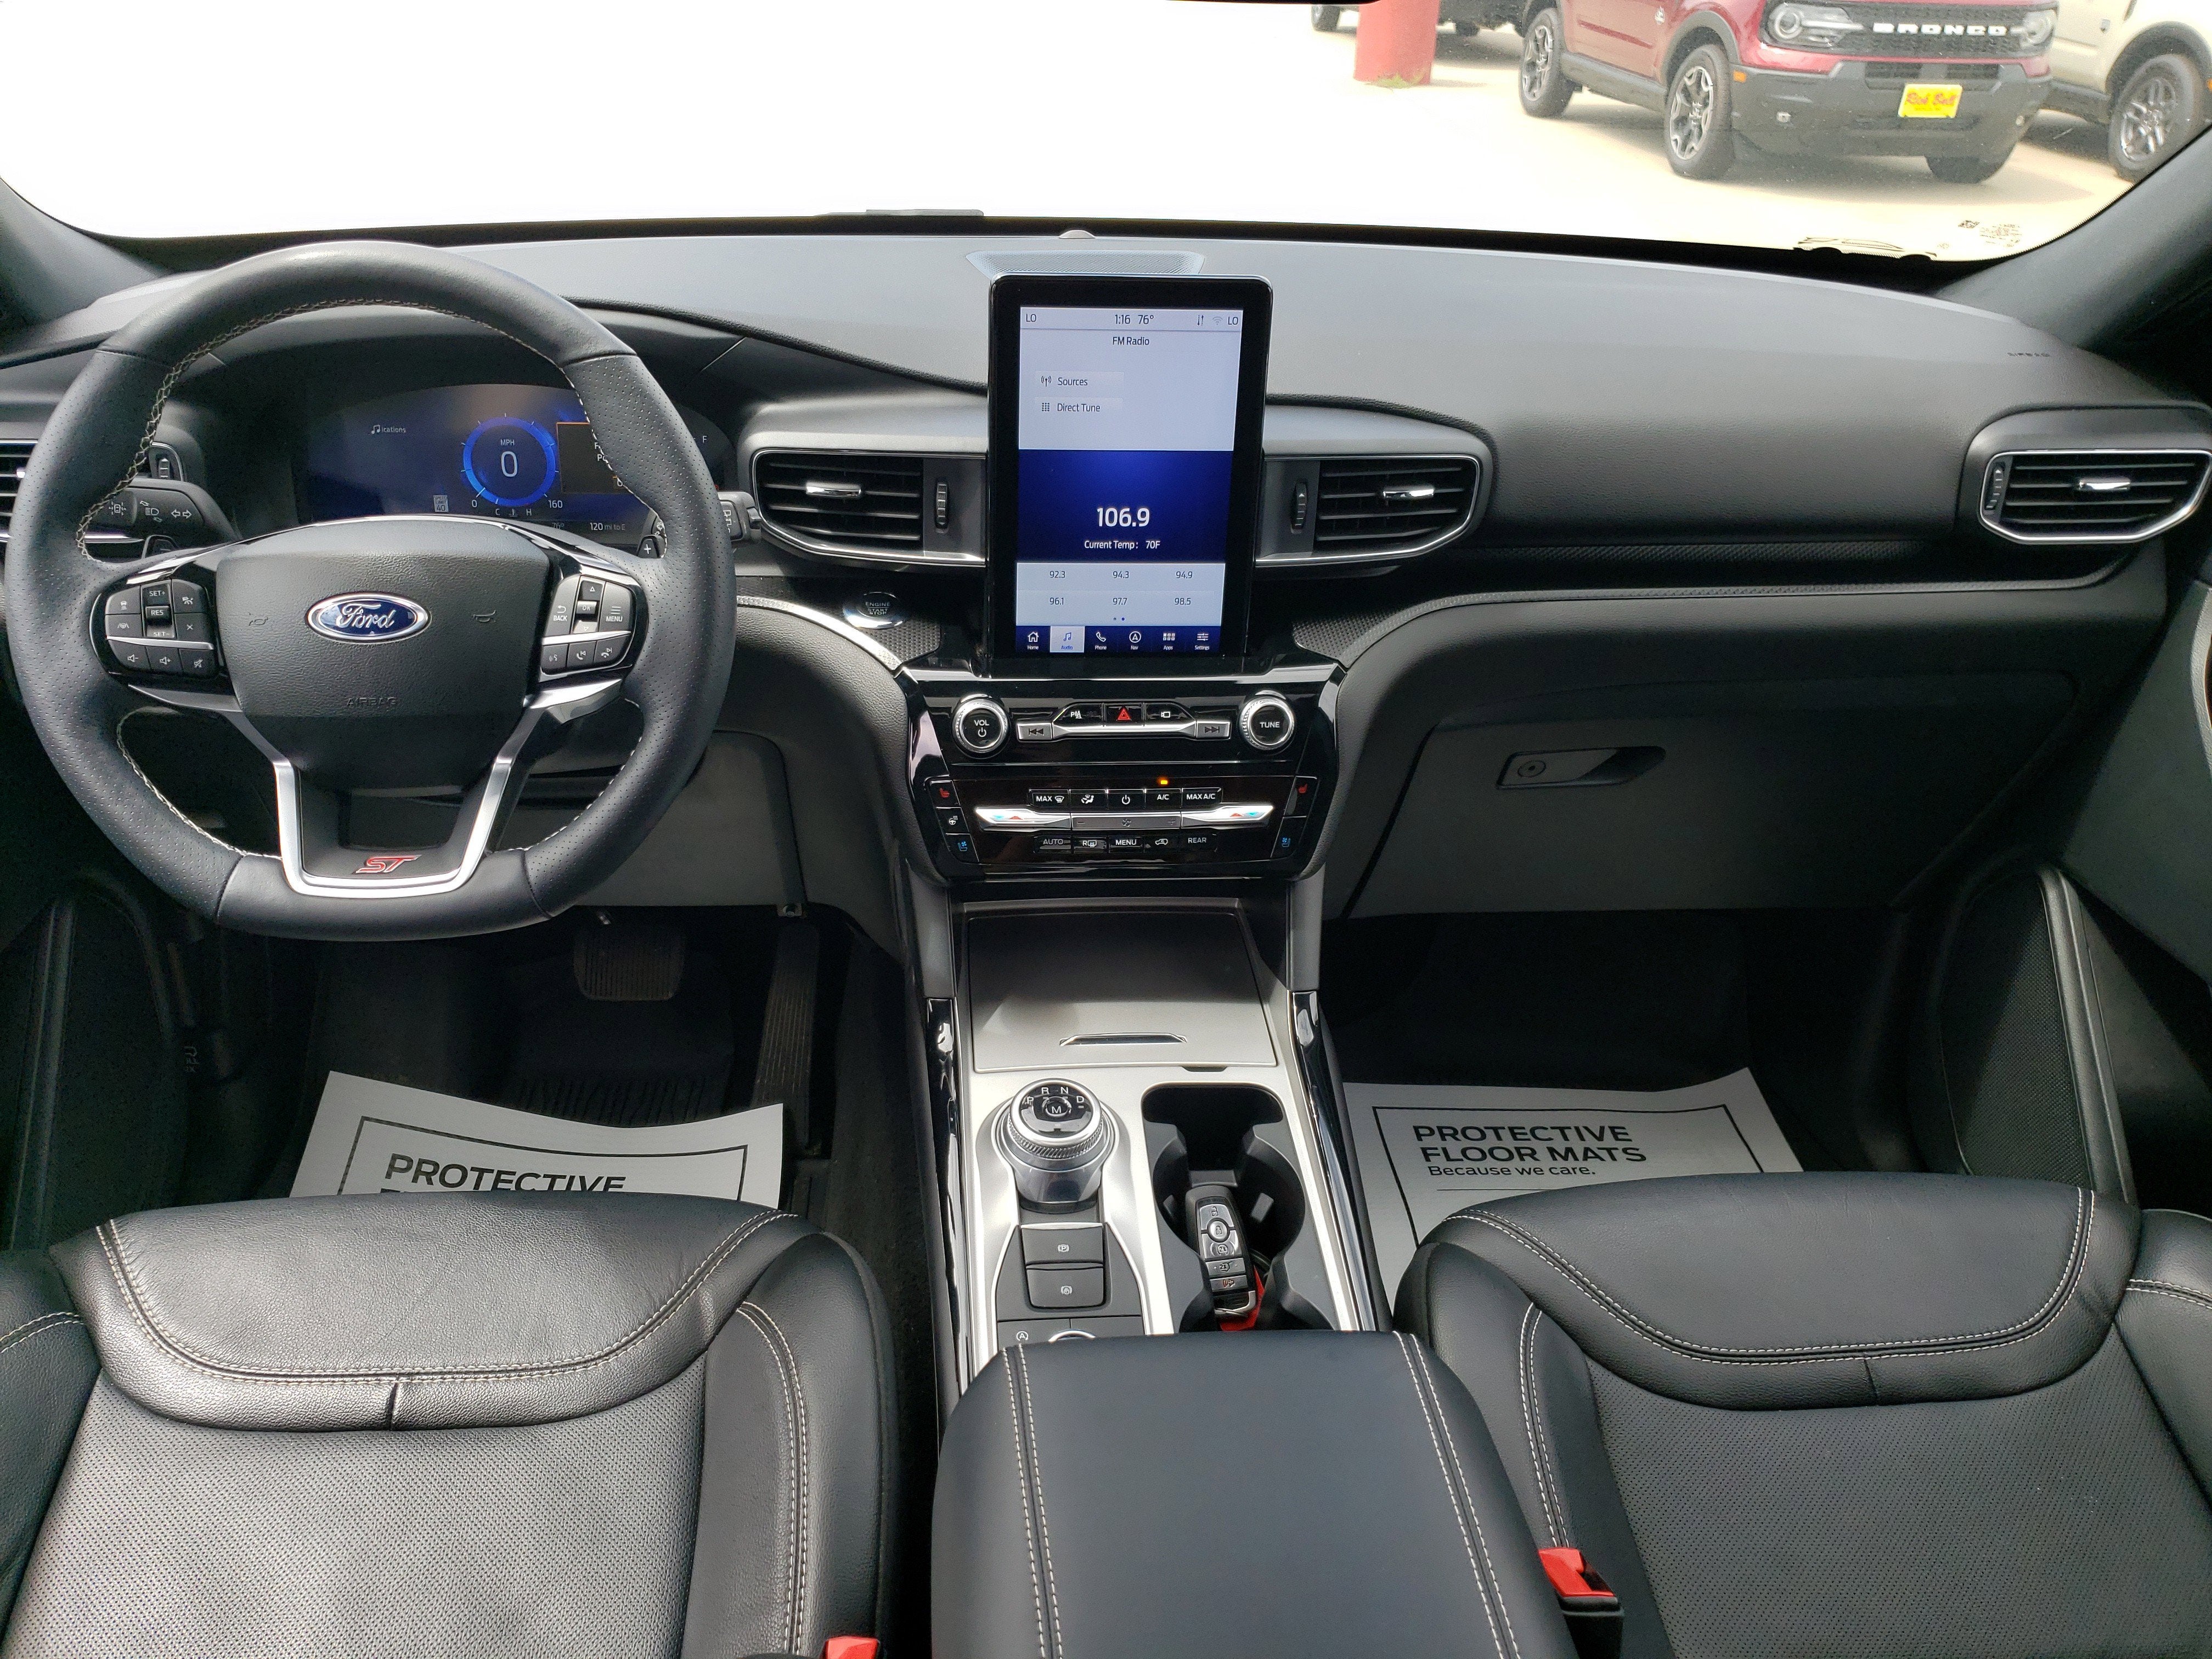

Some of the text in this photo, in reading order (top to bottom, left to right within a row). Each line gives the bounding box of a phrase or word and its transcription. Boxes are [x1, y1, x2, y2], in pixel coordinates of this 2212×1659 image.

[1872, 22, 2008, 36] BRONCO
[1025, 314, 1037, 323] LO
[1115, 314, 1154, 325] 1:16 76°
[1228, 317, 1239, 325] LO
[1113, 337, 1150, 346] FM Radio
[1058, 377, 1088, 386] Sources
[1057, 403, 1101, 412] Direct Tune
[501, 451, 518, 477] 0
[549, 500, 563, 509] 160
[1097, 507, 1150, 527] 106.9
[590, 522, 603, 531] 120
[1084, 540, 1111, 549] Current
[1146, 540, 1161, 549] 70F
[336, 603, 397, 629] Ford
[354, 855, 422, 874] ST
[1051, 1105, 1062, 1114] M
[1413, 1125, 1633, 1142] PROTECTIVE
[1420, 1146, 1646, 1163] FLOOR MATS
[385, 1153, 626, 1192] PROTECTIVE
[1427, 1166, 1596, 1176] Because we care.
